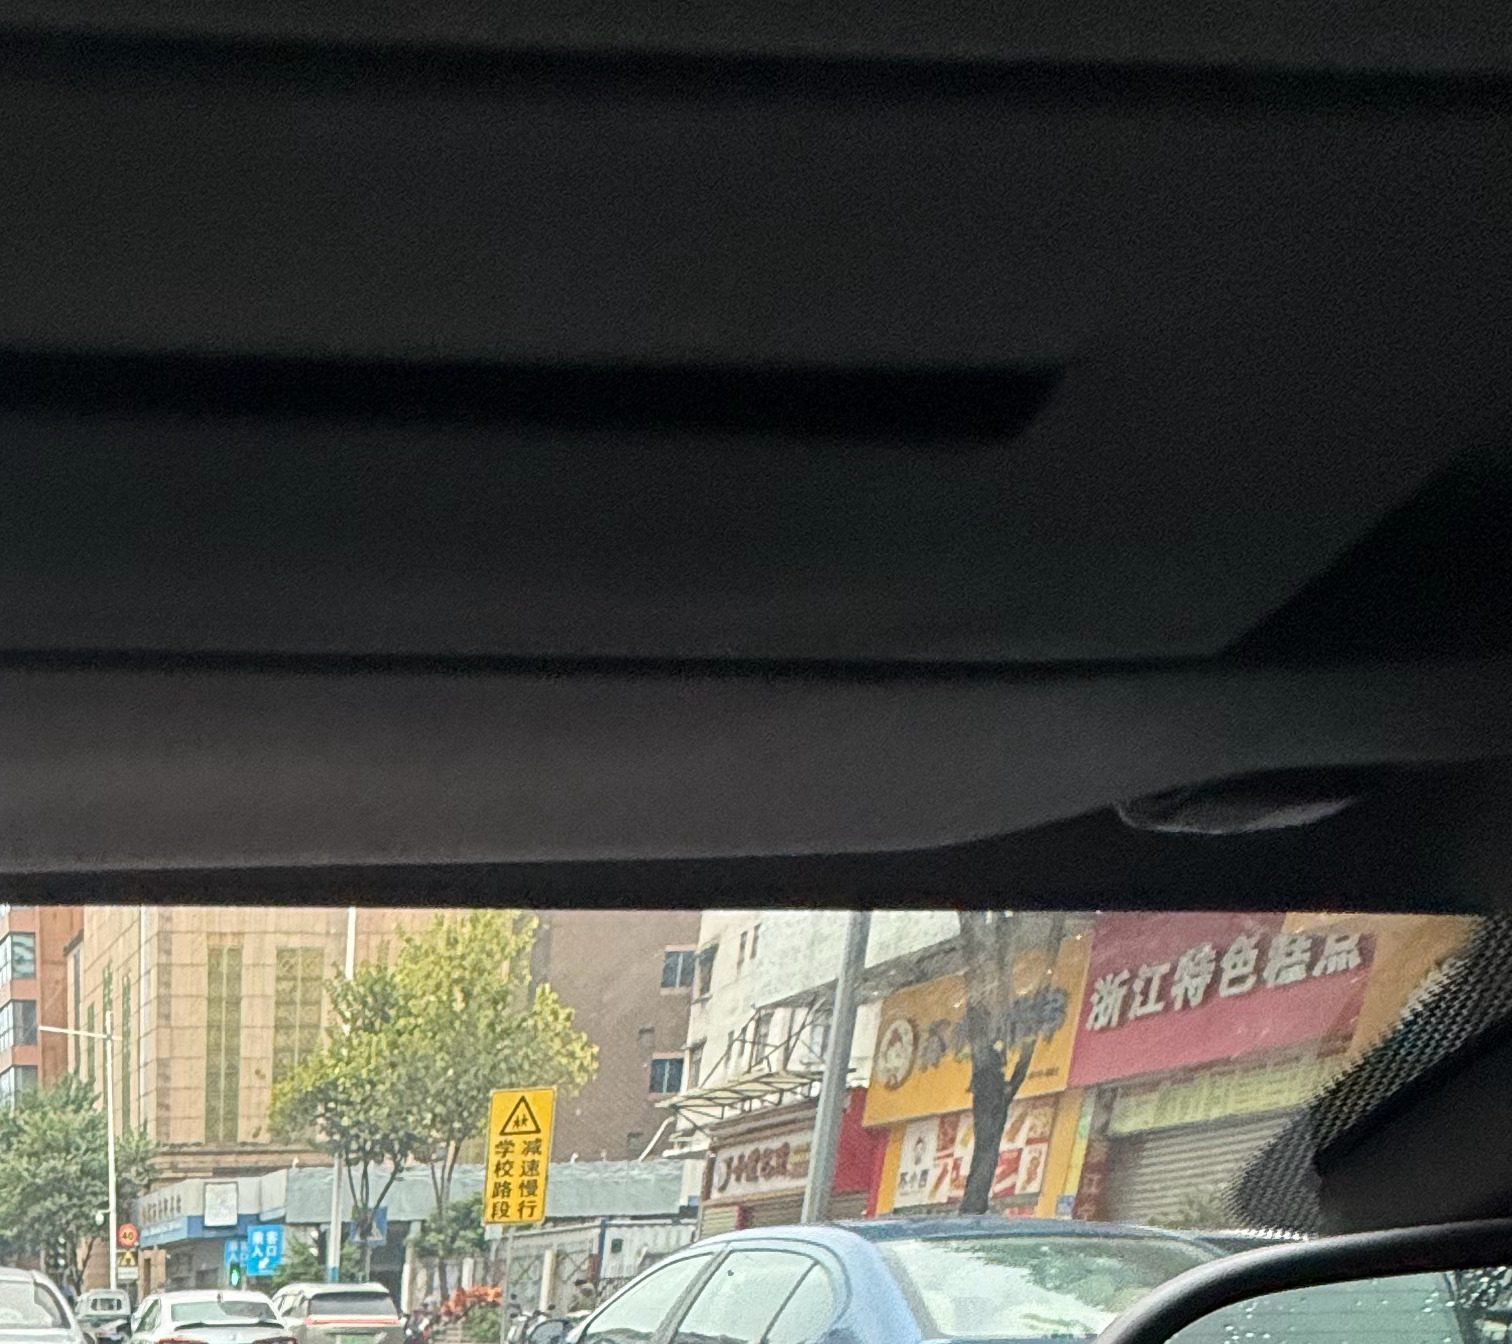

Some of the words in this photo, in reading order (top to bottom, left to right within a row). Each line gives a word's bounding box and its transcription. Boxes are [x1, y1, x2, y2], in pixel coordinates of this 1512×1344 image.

[1086, 933, 1362, 1031] 浙江特色糕点
[491, 1138, 515, 1220] 学校路段
[517, 1137, 542, 1220] 减速慢行
[121, 1231, 134, 1241] 40
[252, 1245, 277, 1258] 入口
